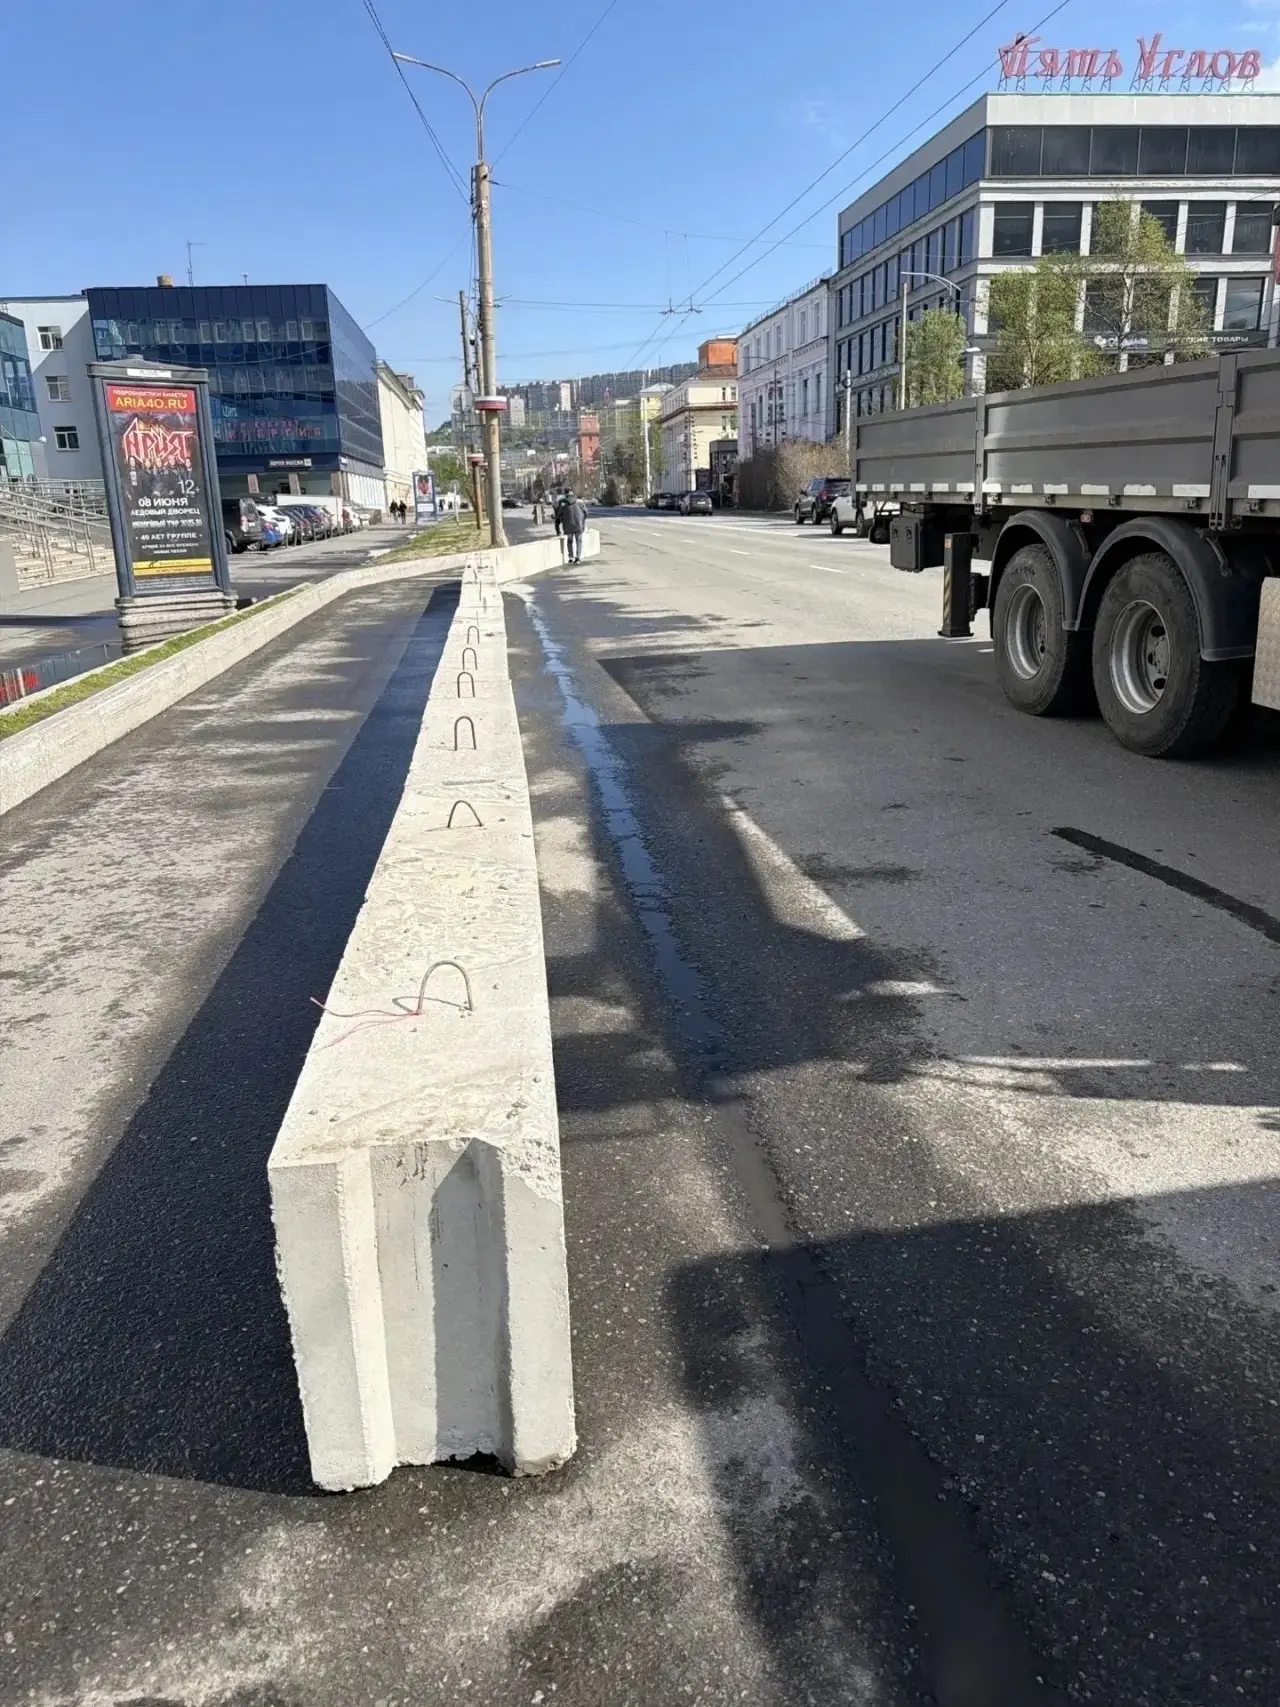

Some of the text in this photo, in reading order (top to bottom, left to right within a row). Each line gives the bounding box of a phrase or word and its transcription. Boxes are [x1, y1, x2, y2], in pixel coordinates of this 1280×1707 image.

[998, 32, 1260, 79] Пять Углов
[115, 397, 188, 409] ARIA40.RU
[177, 479, 200, 494] 12+
[138, 497, 188, 507] 08 ИЮНЯ
[131, 508, 200, 516] ЛЕДОВЫЙ ДВОРЕЦ
[166, 532, 197, 540] ГРУППЕ
